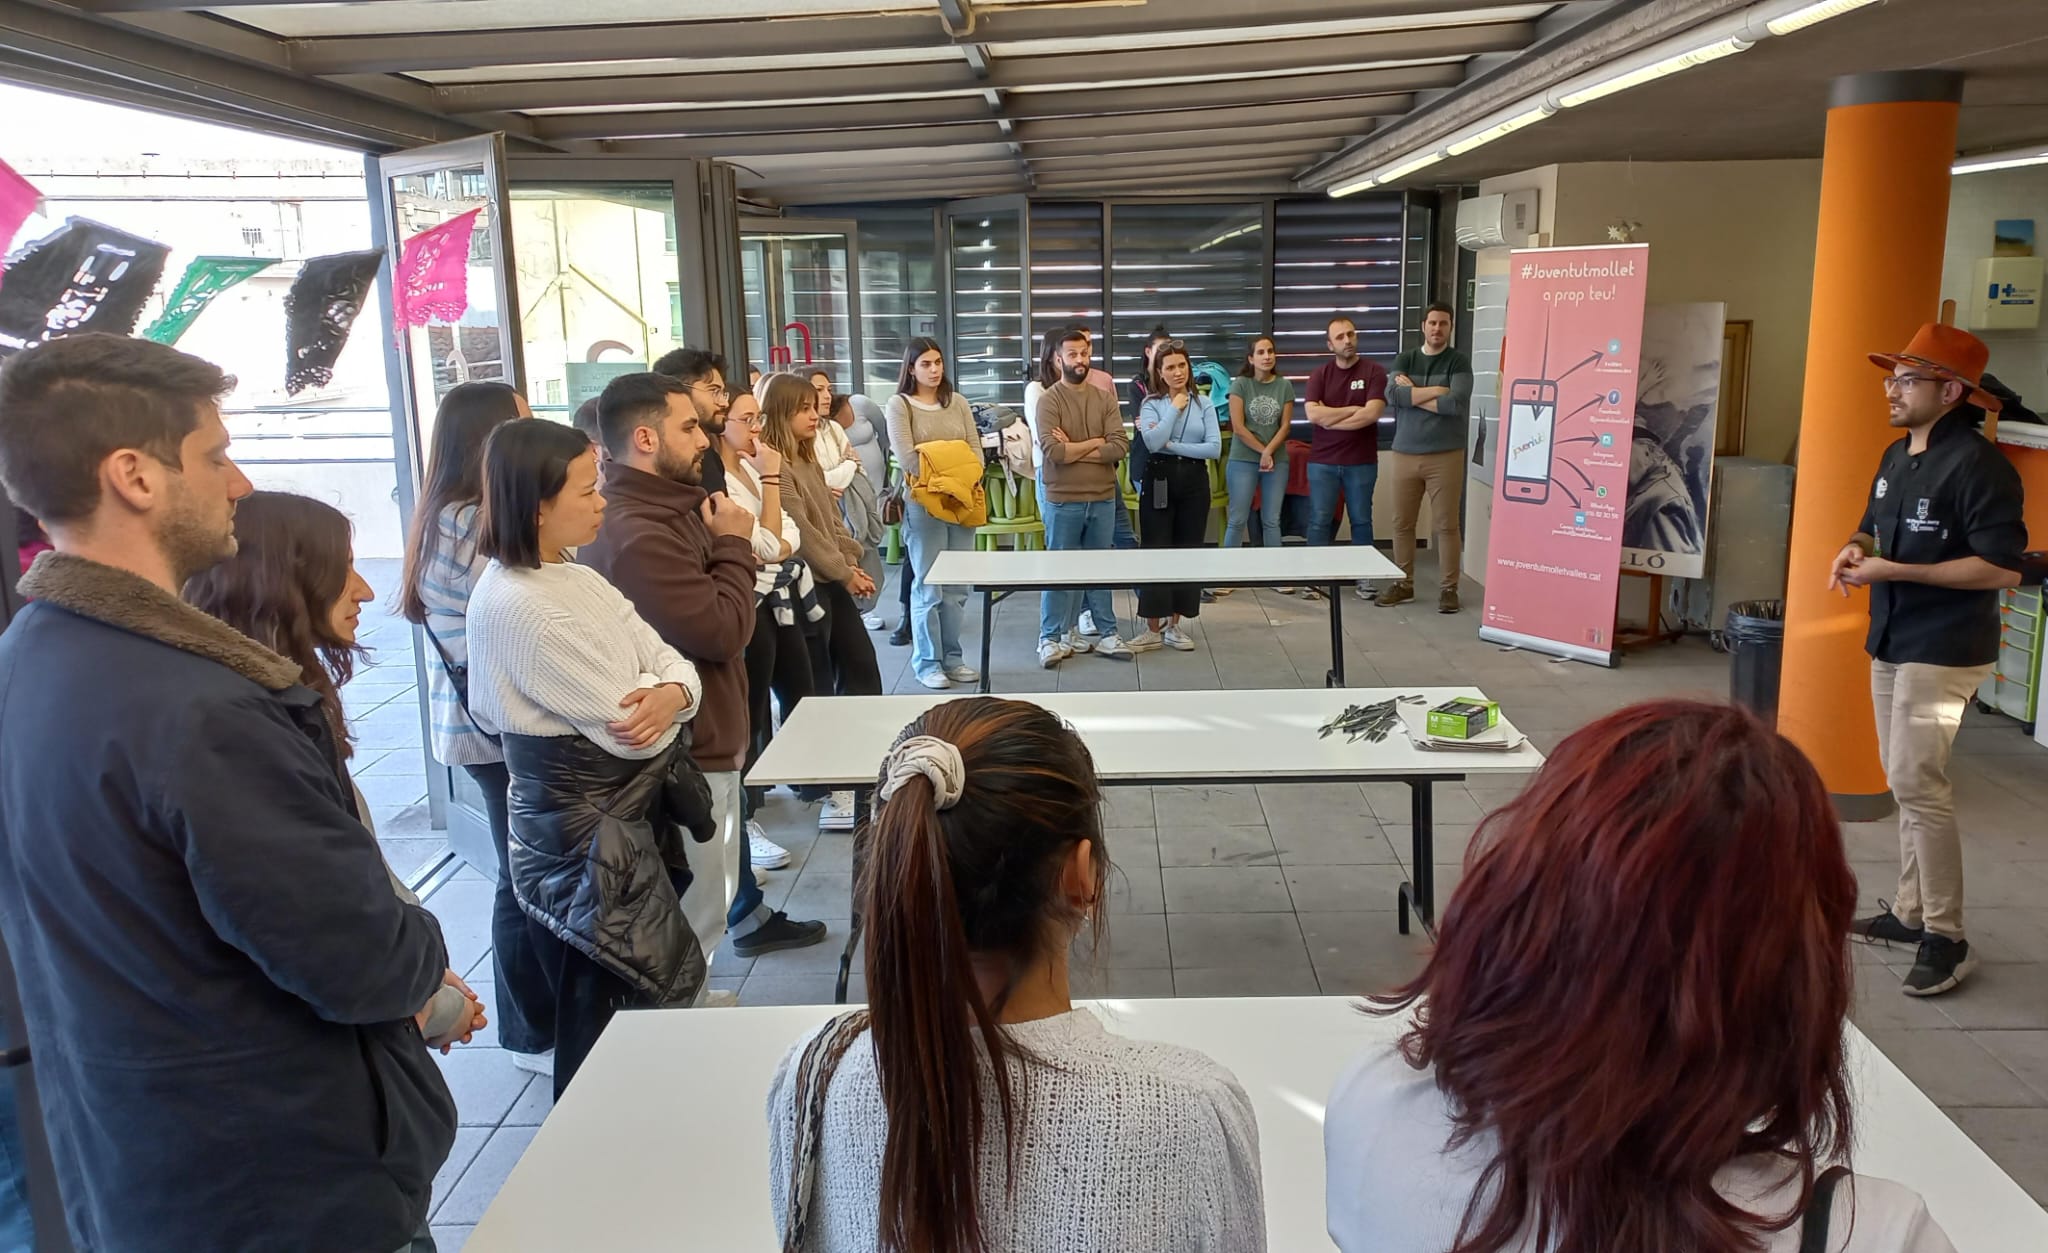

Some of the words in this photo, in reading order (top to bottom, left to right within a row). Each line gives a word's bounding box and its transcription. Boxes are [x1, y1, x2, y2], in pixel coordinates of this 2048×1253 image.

[1521, 261, 1635, 280] #Joventutmollet
[1543, 292, 1551, 301] a
[1554, 290, 1585, 307] prop
[1589, 285, 1616, 301] teu!
